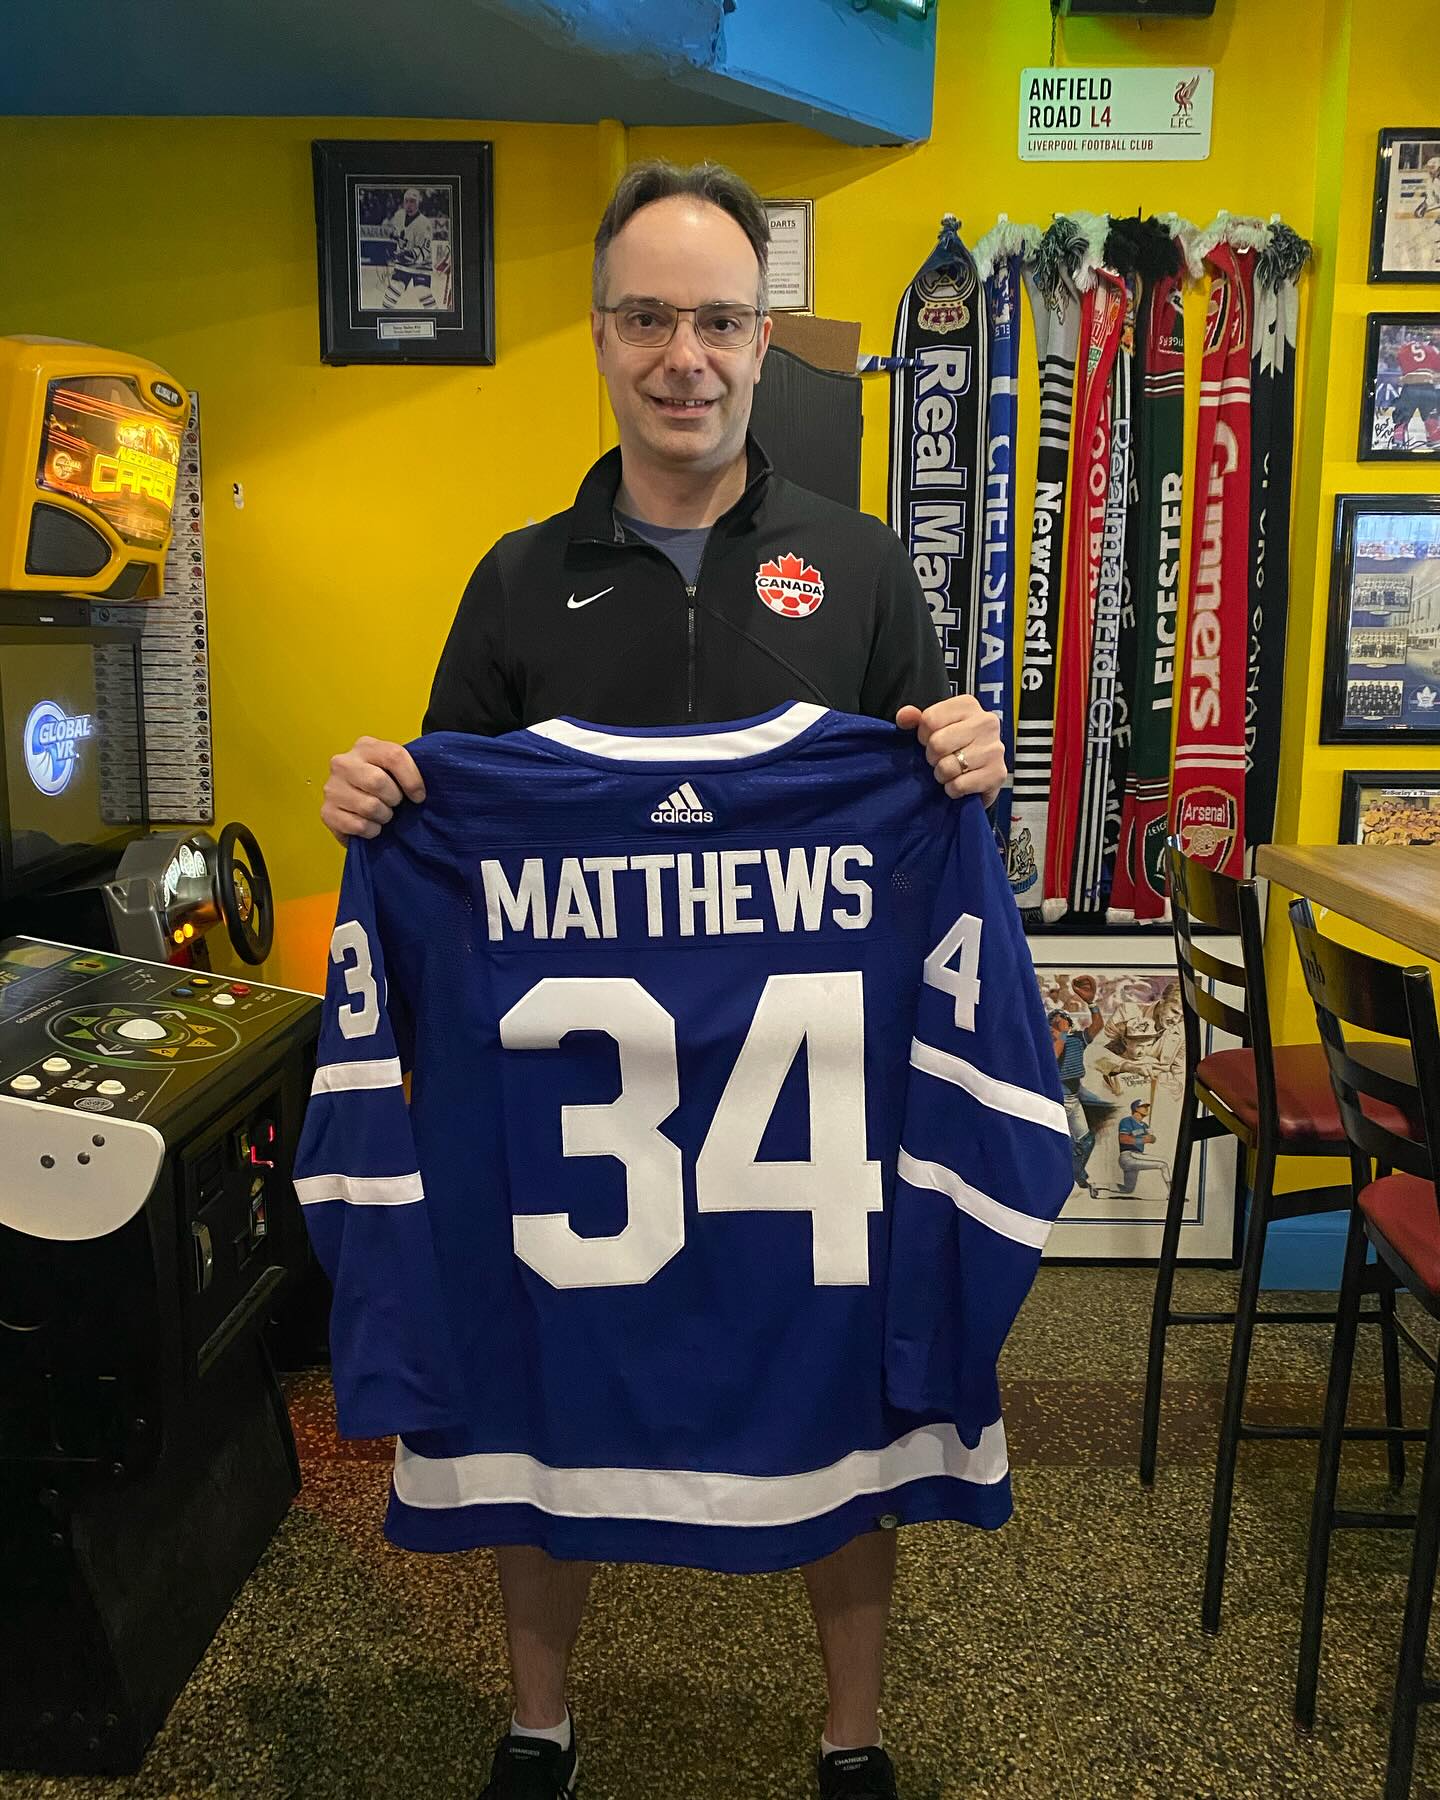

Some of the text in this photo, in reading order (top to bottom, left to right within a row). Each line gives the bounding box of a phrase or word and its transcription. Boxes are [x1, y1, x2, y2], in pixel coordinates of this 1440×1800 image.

[1029, 78, 1112, 101] ANFIELD
[1029, 105, 1112, 128] ROAD L4
[1028, 140, 1153, 151] LIVERPOOL FOOTBALL CLUB
[770, 220, 796, 229] DARTS
[909, 345, 970, 694] Real Mad
[980, 434, 1010, 668] CHELSEA
[758, 576, 822, 597] CANADA
[1022, 480, 1064, 691] Newcastle
[1190, 420, 1239, 731] Gunners
[1152, 471, 1184, 712] LEICESTER
[39, 717, 91, 745] GLOBAL
[56, 740, 76, 760] VR
[650, 808, 714, 824] adidas
[1184, 802, 1226, 823] Arsenal
[480, 844, 874, 942] MATTHEWS
[924, 913, 984, 1032] 4
[499, 970, 884, 1290] 34
